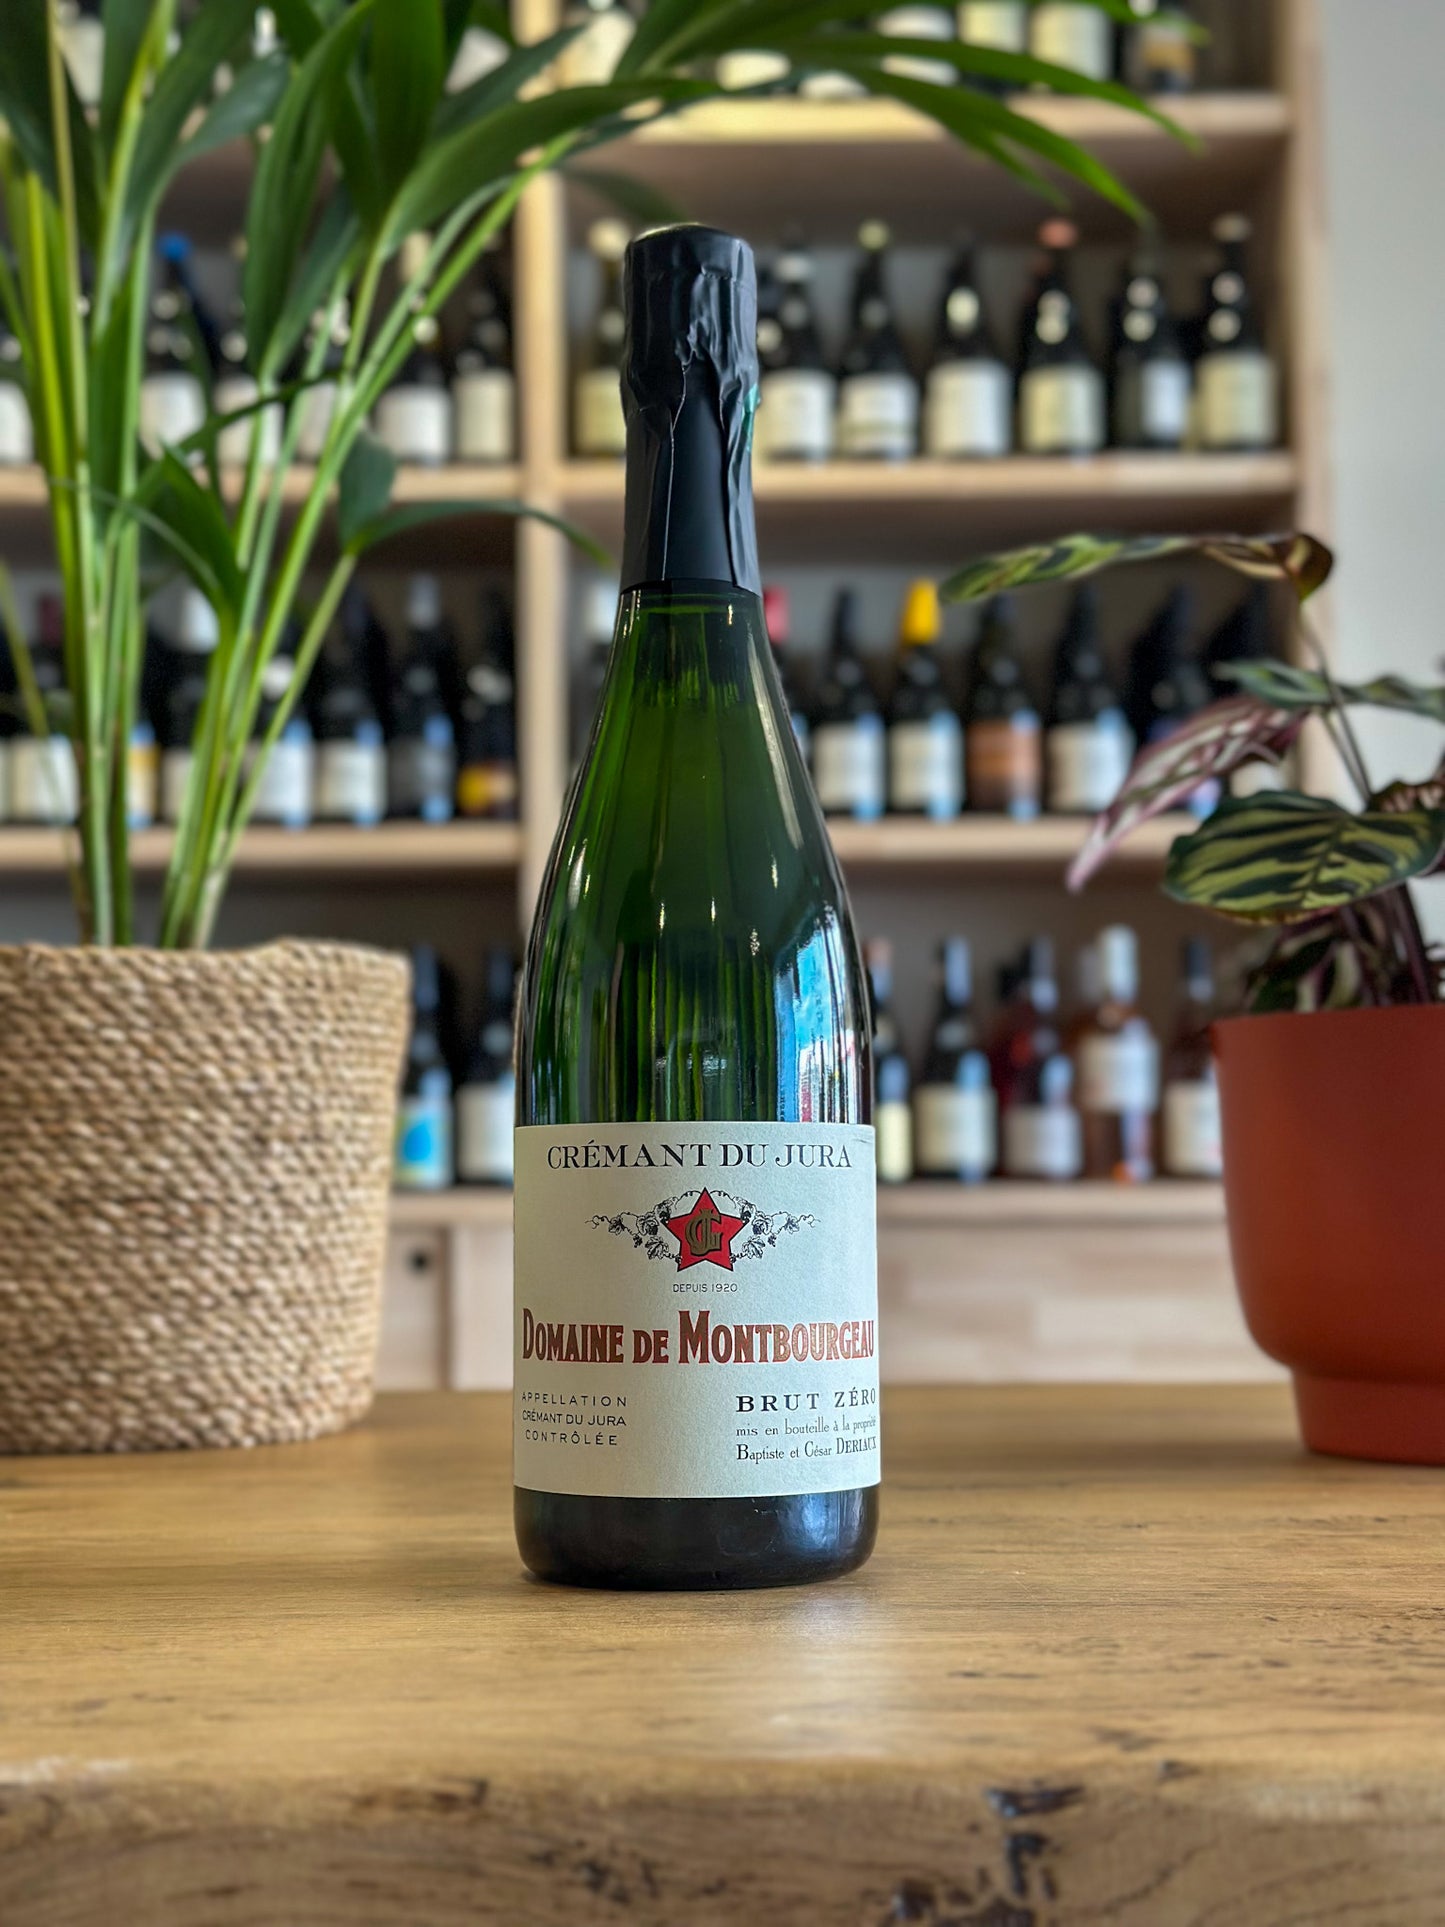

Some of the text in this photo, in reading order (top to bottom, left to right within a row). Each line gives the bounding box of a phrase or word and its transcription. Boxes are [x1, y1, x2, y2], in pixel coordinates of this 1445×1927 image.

[547, 1140, 852, 1169] CRÉMANT DU JURA
[672, 1284, 738, 1293] DEPUIS 1920
[522, 1308, 875, 1365] DOMAINE DE MONTBOURGEAU
[522, 1392, 627, 1407] APPELLATION
[736, 1386, 876, 1412] BRUT ZÉRO
[522, 1408, 626, 1426] CRÉMANT DU JURA
[736, 1423, 758, 1436] mis
[765, 1428, 779, 1436] en
[785, 1416, 830, 1435] bouteille
[833, 1420, 838, 1432] à
[842, 1414, 850, 1430] la
[526, 1430, 618, 1446] CONTRÔLÉE
[736, 1444, 785, 1464] Baptiste
[790, 1447, 800, 1458] et
[804, 1440, 832, 1457] César
